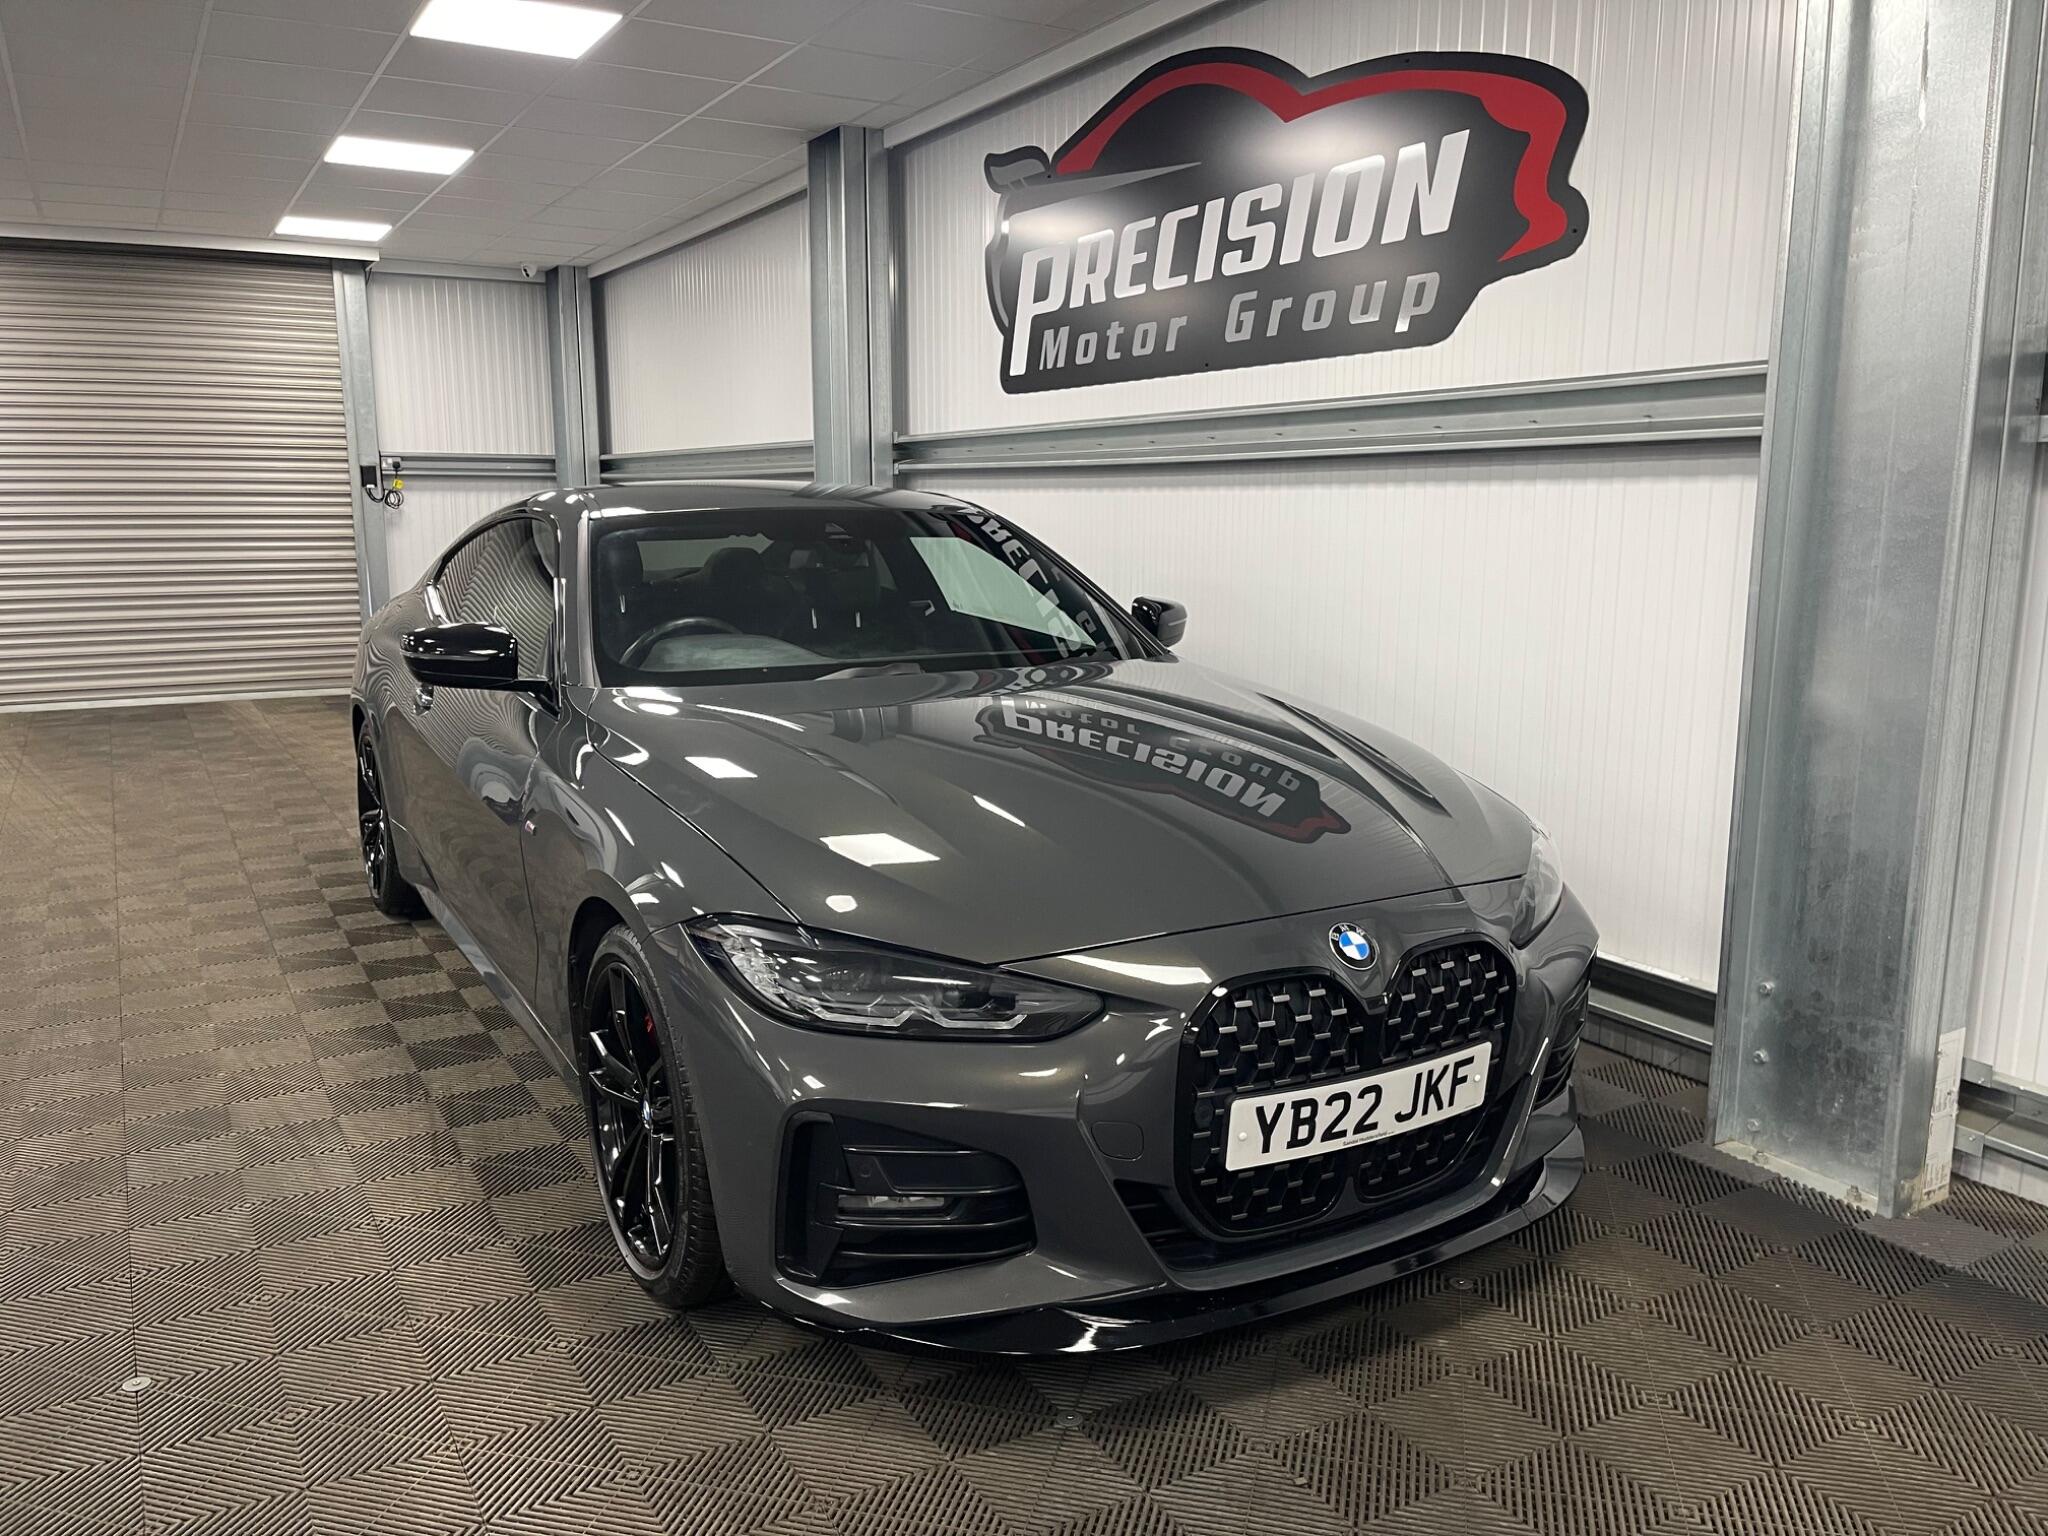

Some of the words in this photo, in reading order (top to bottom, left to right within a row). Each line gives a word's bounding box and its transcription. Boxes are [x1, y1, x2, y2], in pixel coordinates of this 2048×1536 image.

[1009, 129, 1470, 376] PRECISION
[1039, 315, 1188, 370] Motor
[1224, 271, 1440, 343] Group
[1330, 924, 1366, 941] BMW
[1256, 1085, 1383, 1154] YB22
[1394, 1055, 1475, 1123] JKF
